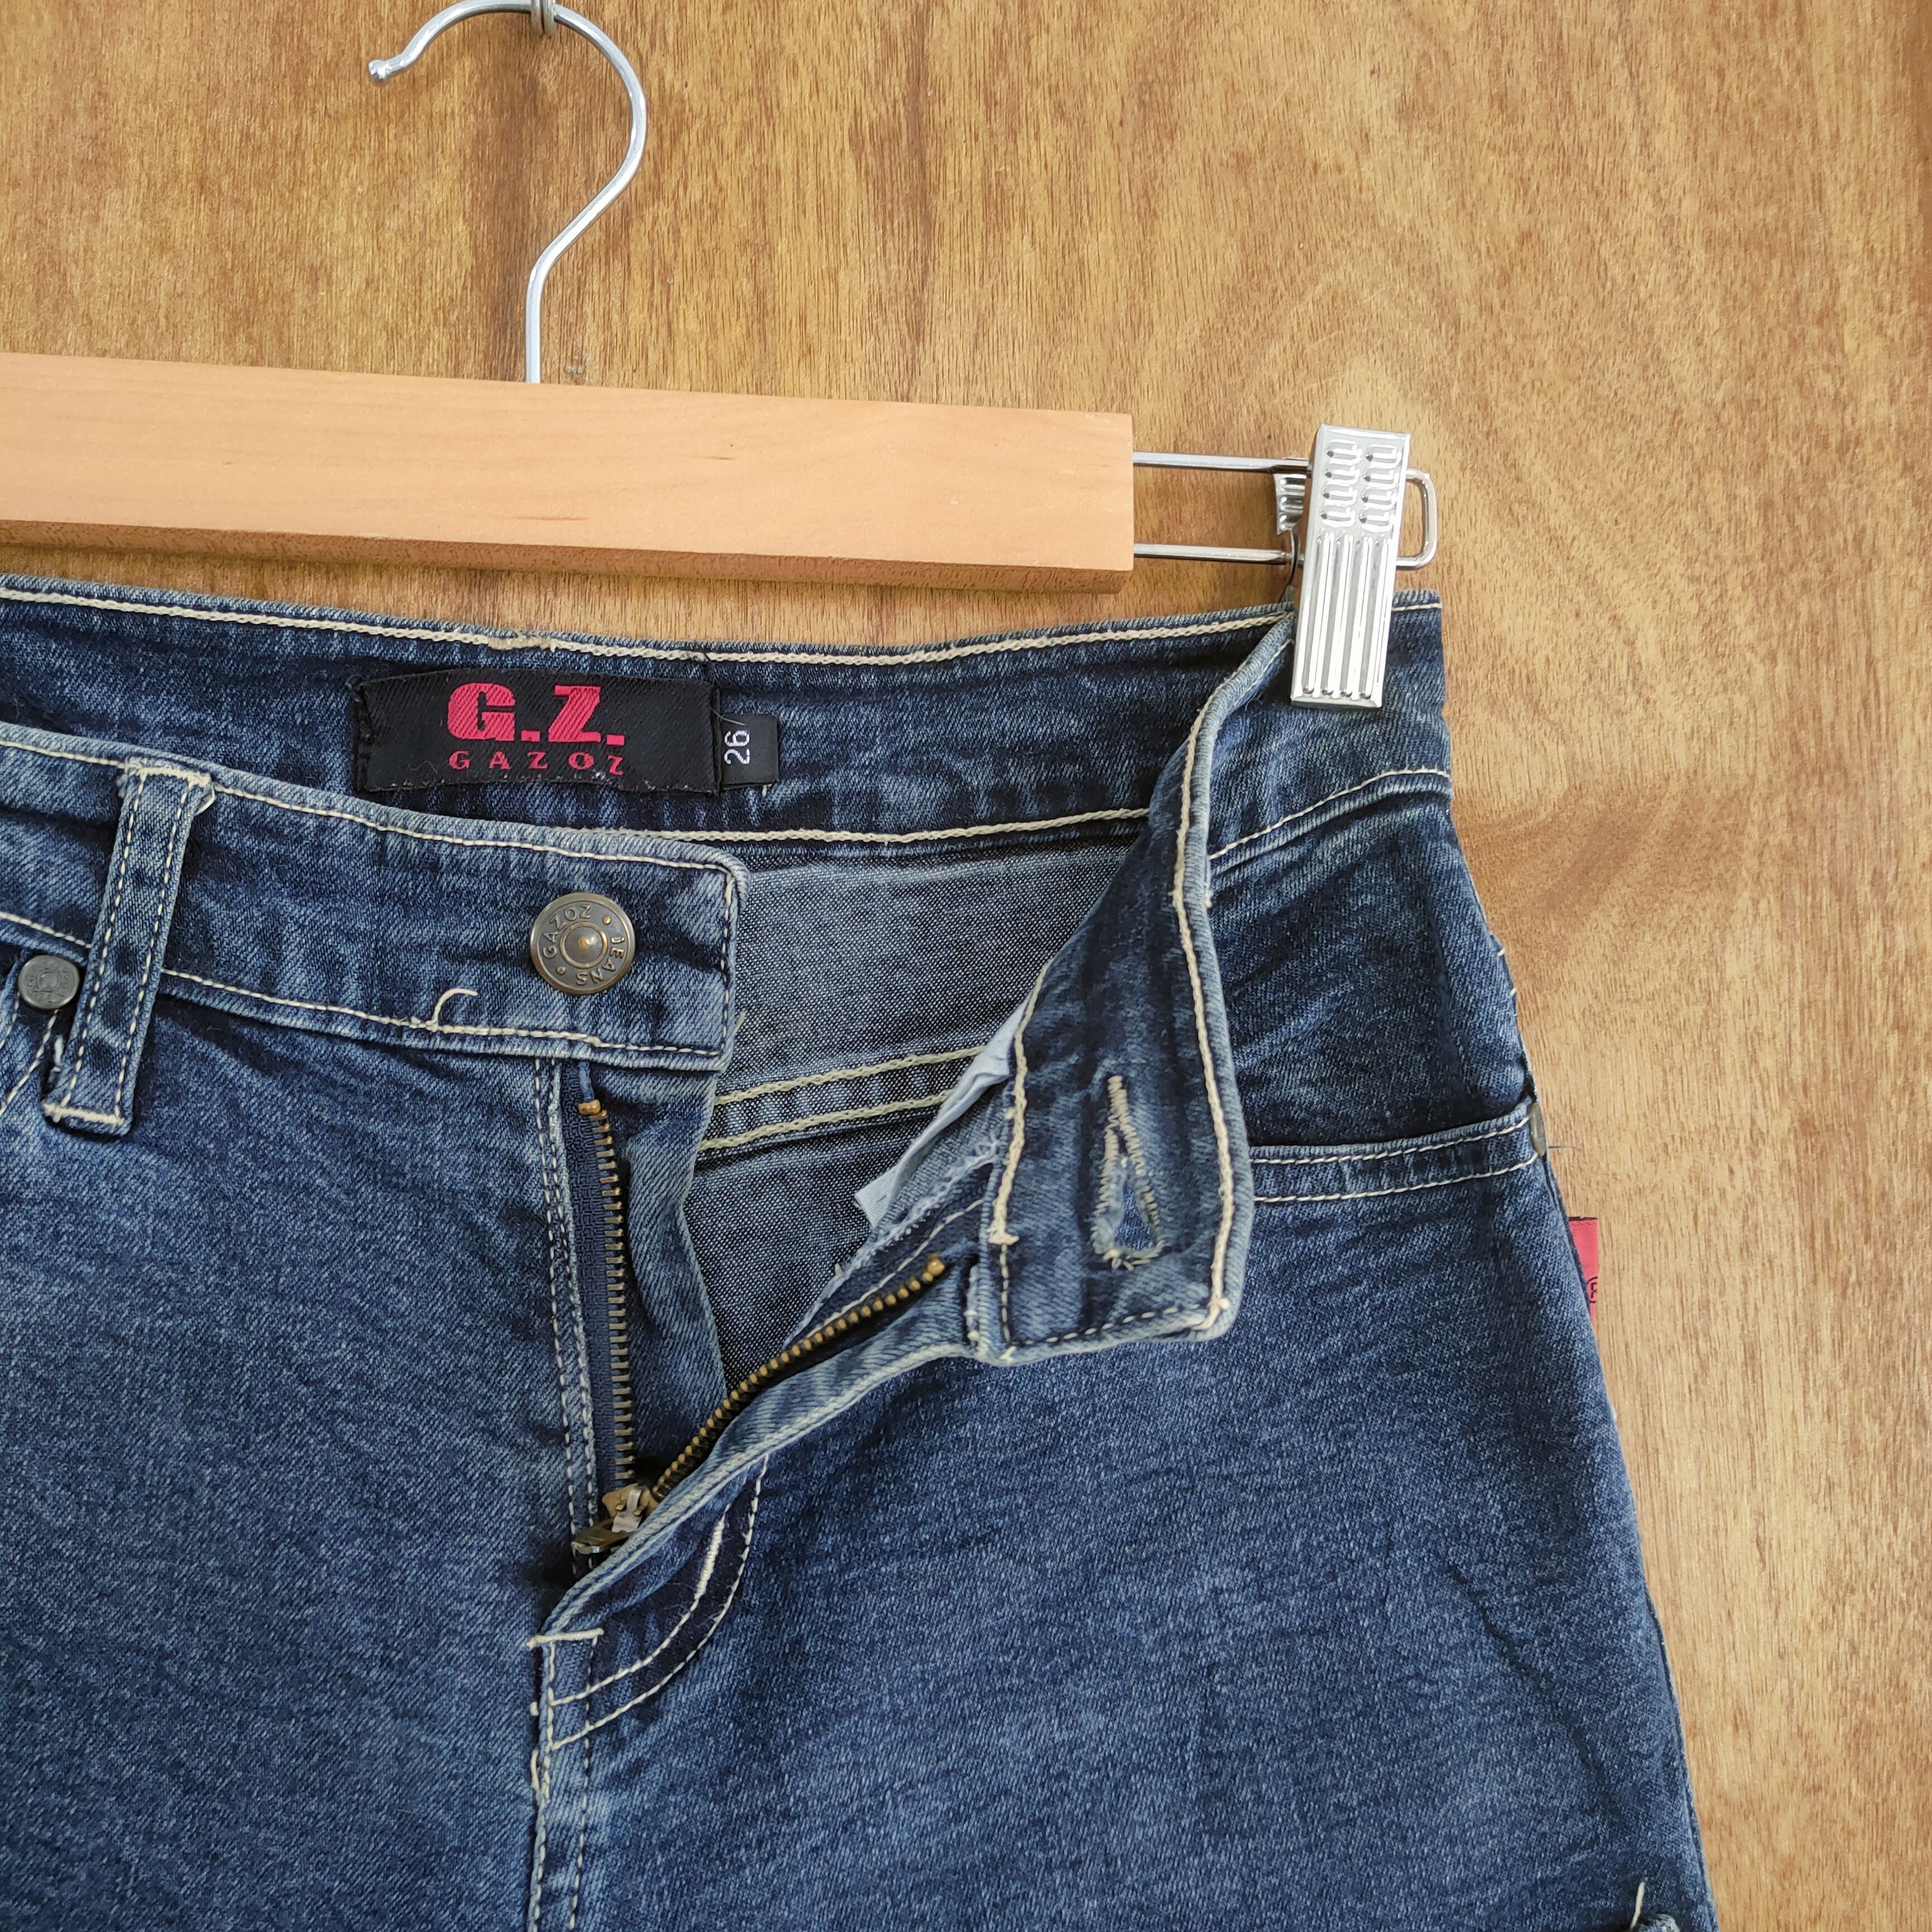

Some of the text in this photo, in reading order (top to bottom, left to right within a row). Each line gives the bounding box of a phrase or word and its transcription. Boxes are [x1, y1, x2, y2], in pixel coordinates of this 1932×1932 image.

[447, 682, 625, 746] G.Z.
[448, 750, 624, 776] GAZOZ
[724, 730, 750, 765] 26
[543, 905, 625, 985] GAZOZ JEANS
